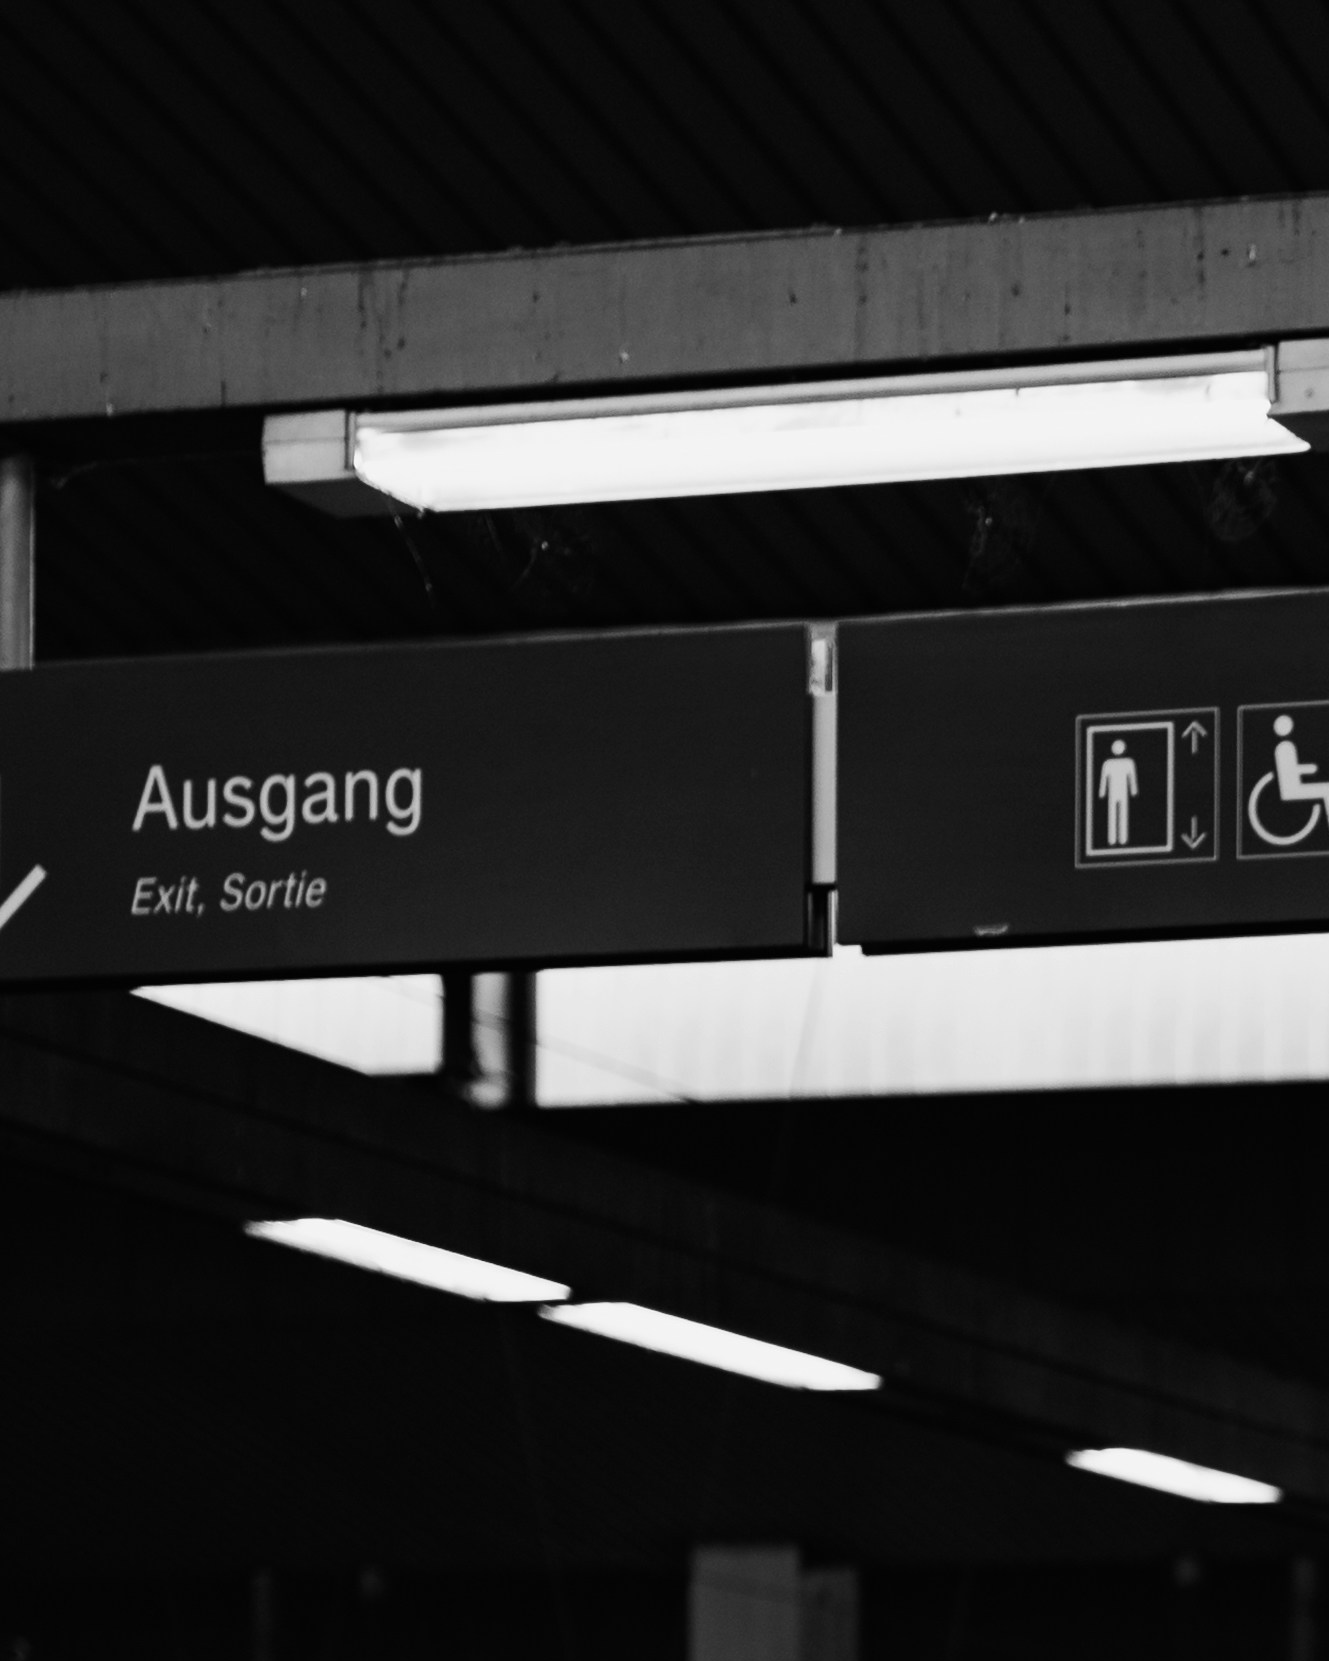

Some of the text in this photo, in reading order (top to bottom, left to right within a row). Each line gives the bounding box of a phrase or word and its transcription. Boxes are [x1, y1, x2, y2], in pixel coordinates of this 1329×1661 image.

[131, 763, 423, 843] Ausgang
[131, 870, 329, 918] Exit, Sortie
